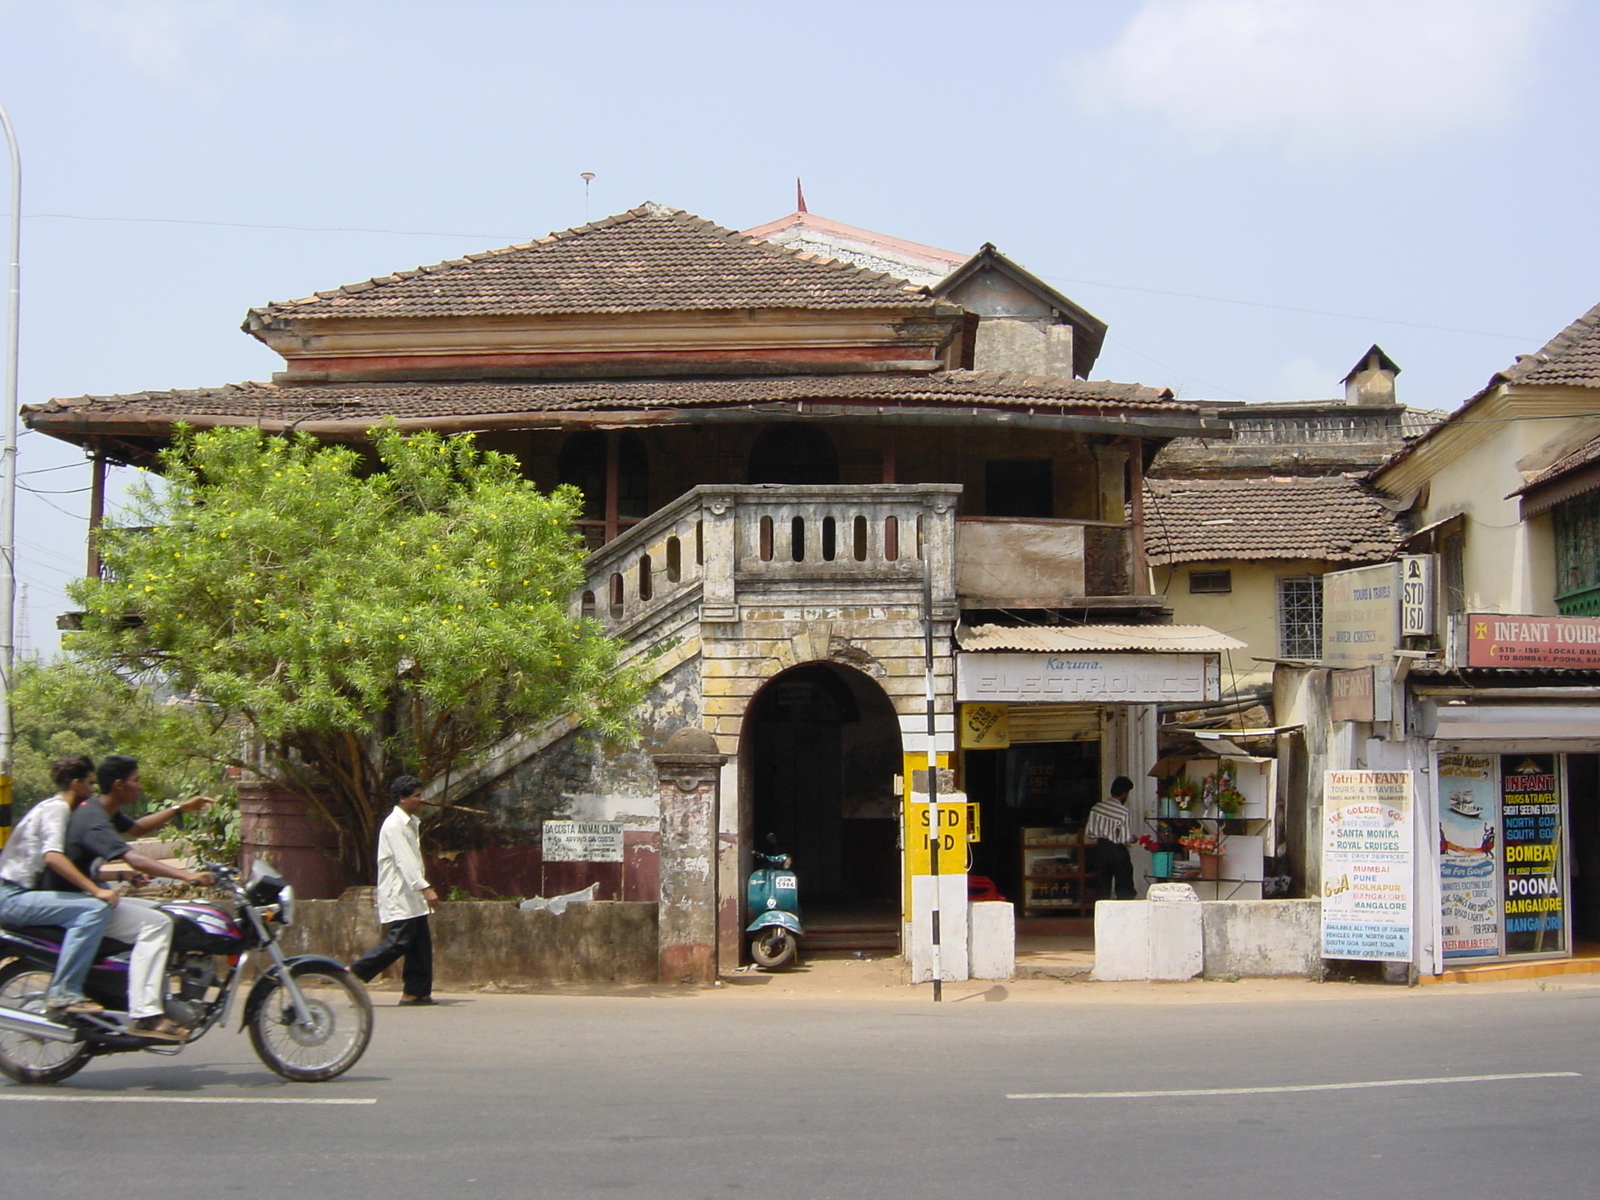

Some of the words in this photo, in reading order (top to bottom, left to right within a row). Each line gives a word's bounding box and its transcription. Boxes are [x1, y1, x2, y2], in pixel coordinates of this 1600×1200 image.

[1404, 582, 1424, 604] STD
[1405, 607, 1424, 630] ISD
[1494, 622, 1550, 642] INFANT
[1046, 658, 1102, 670] Karuna
[976, 674, 1200, 694] ELECTRONICS
[1333, 674, 1371, 697] INFANT
[972, 706, 986, 722] STD
[978, 711, 991, 726] ISD
[1331, 773, 1353, 784] Yatri
[1359, 773, 1408, 784] INFANT
[1505, 774, 1555, 791] INFANT
[1504, 794, 1524, 804] TOURS
[1525, 794, 1529, 804] &
[1530, 793, 1558, 803] TRAVELS
[1347, 806, 1383, 815] GOLDEN
[1503, 805, 1518, 815] SIGHT
[1520, 805, 1540, 815] SEEING
[1541, 804, 1560, 815] TOURS
[921, 810, 959, 827] STD
[1506, 818, 1534, 828] NORTH
[1539, 817, 1556, 826] GOA
[545, 824, 553, 834] DA
[555, 824, 575, 834] COSTA
[578, 824, 600, 834] ANIMAL
[602, 824, 622, 834] CLINIC
[1337, 829, 1364, 838] SANTA
[1367, 830, 1399, 838] MONIKA
[1507, 829, 1534, 840] SOUTH
[1539, 828, 1556, 838] GOA
[1337, 841, 1361, 849] ROYAL
[1364, 842, 1400, 850] CRUISES
[1506, 845, 1559, 862] BOMBAY
[1509, 877, 1558, 896] POONA
[1505, 898, 1562, 913] BANGALORE
[1506, 916, 1563, 932] MANGALORE
